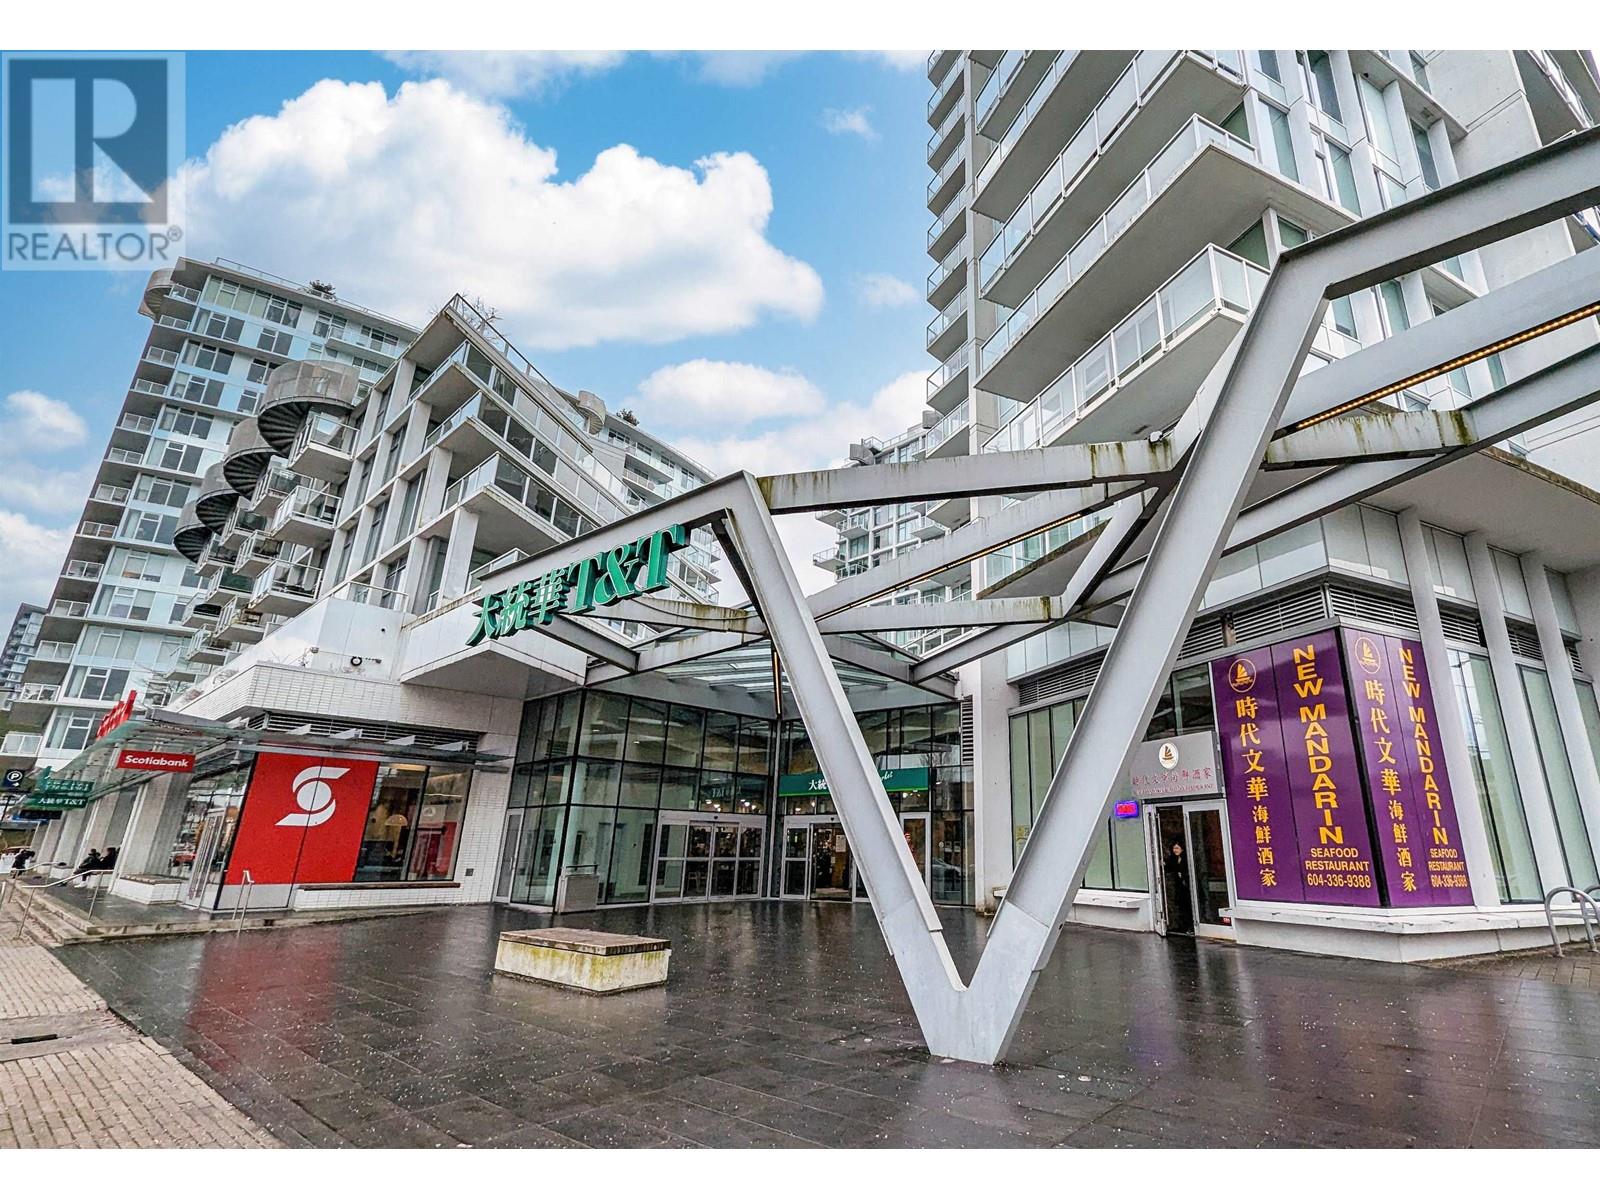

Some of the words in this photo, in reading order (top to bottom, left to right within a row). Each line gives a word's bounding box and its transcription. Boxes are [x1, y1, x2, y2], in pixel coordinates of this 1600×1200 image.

[466, 568, 571, 646] 大統華
[565, 523, 686, 614] T&T
[1293, 644, 1324, 699] NEW
[1398, 647, 1421, 699] NEW
[124, 754, 189, 767] Scotiabank
[1299, 703, 1344, 845] MANDARIN
[1408, 706, 1449, 845] MANDARIN
[808, 778, 828, 791] 大統
[1235, 695, 1278, 888] 時代文華海鮮酒家
[1364, 679, 1417, 892] 時代文華海鮮酒家
[1305, 860, 1370, 872] RESTAURANT
[1310, 847, 1359, 858] SEAFOOD
[1428, 861, 1465, 871] RESTAURANT
[1430, 848, 1458, 858] SEAFOOD
[1307, 873, 1371, 889] 604-336-9388
